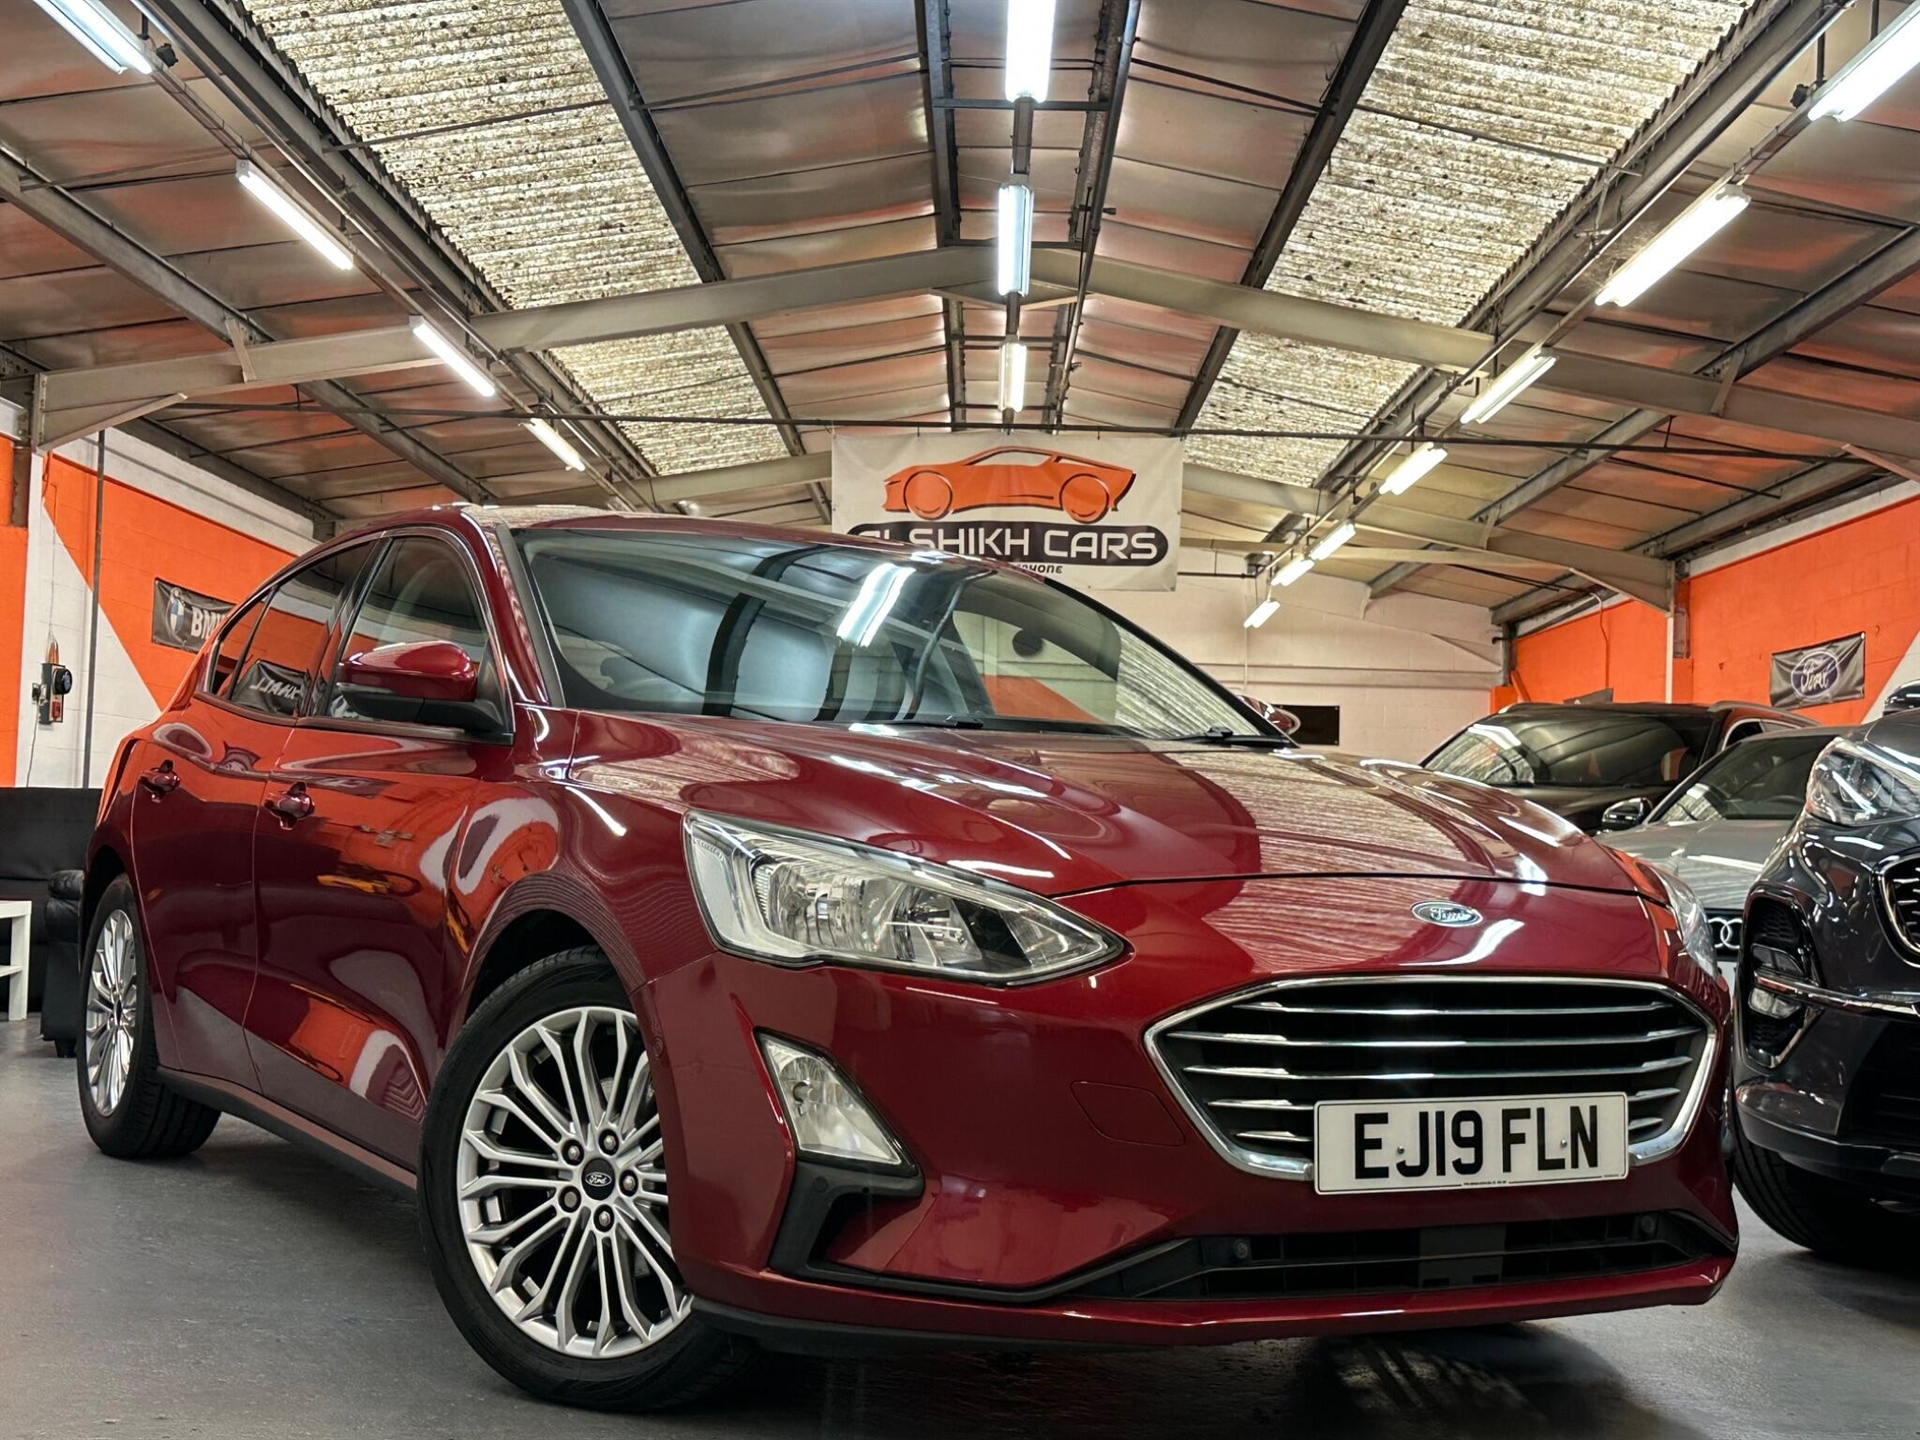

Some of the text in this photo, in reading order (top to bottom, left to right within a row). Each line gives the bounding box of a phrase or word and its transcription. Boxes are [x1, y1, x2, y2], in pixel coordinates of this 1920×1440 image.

[909, 527, 1029, 556] SHIKH
[1044, 530, 1158, 560] CARS
[1800, 657, 1831, 693] Ford
[1354, 1105, 1598, 1180] EJ19 FLN
